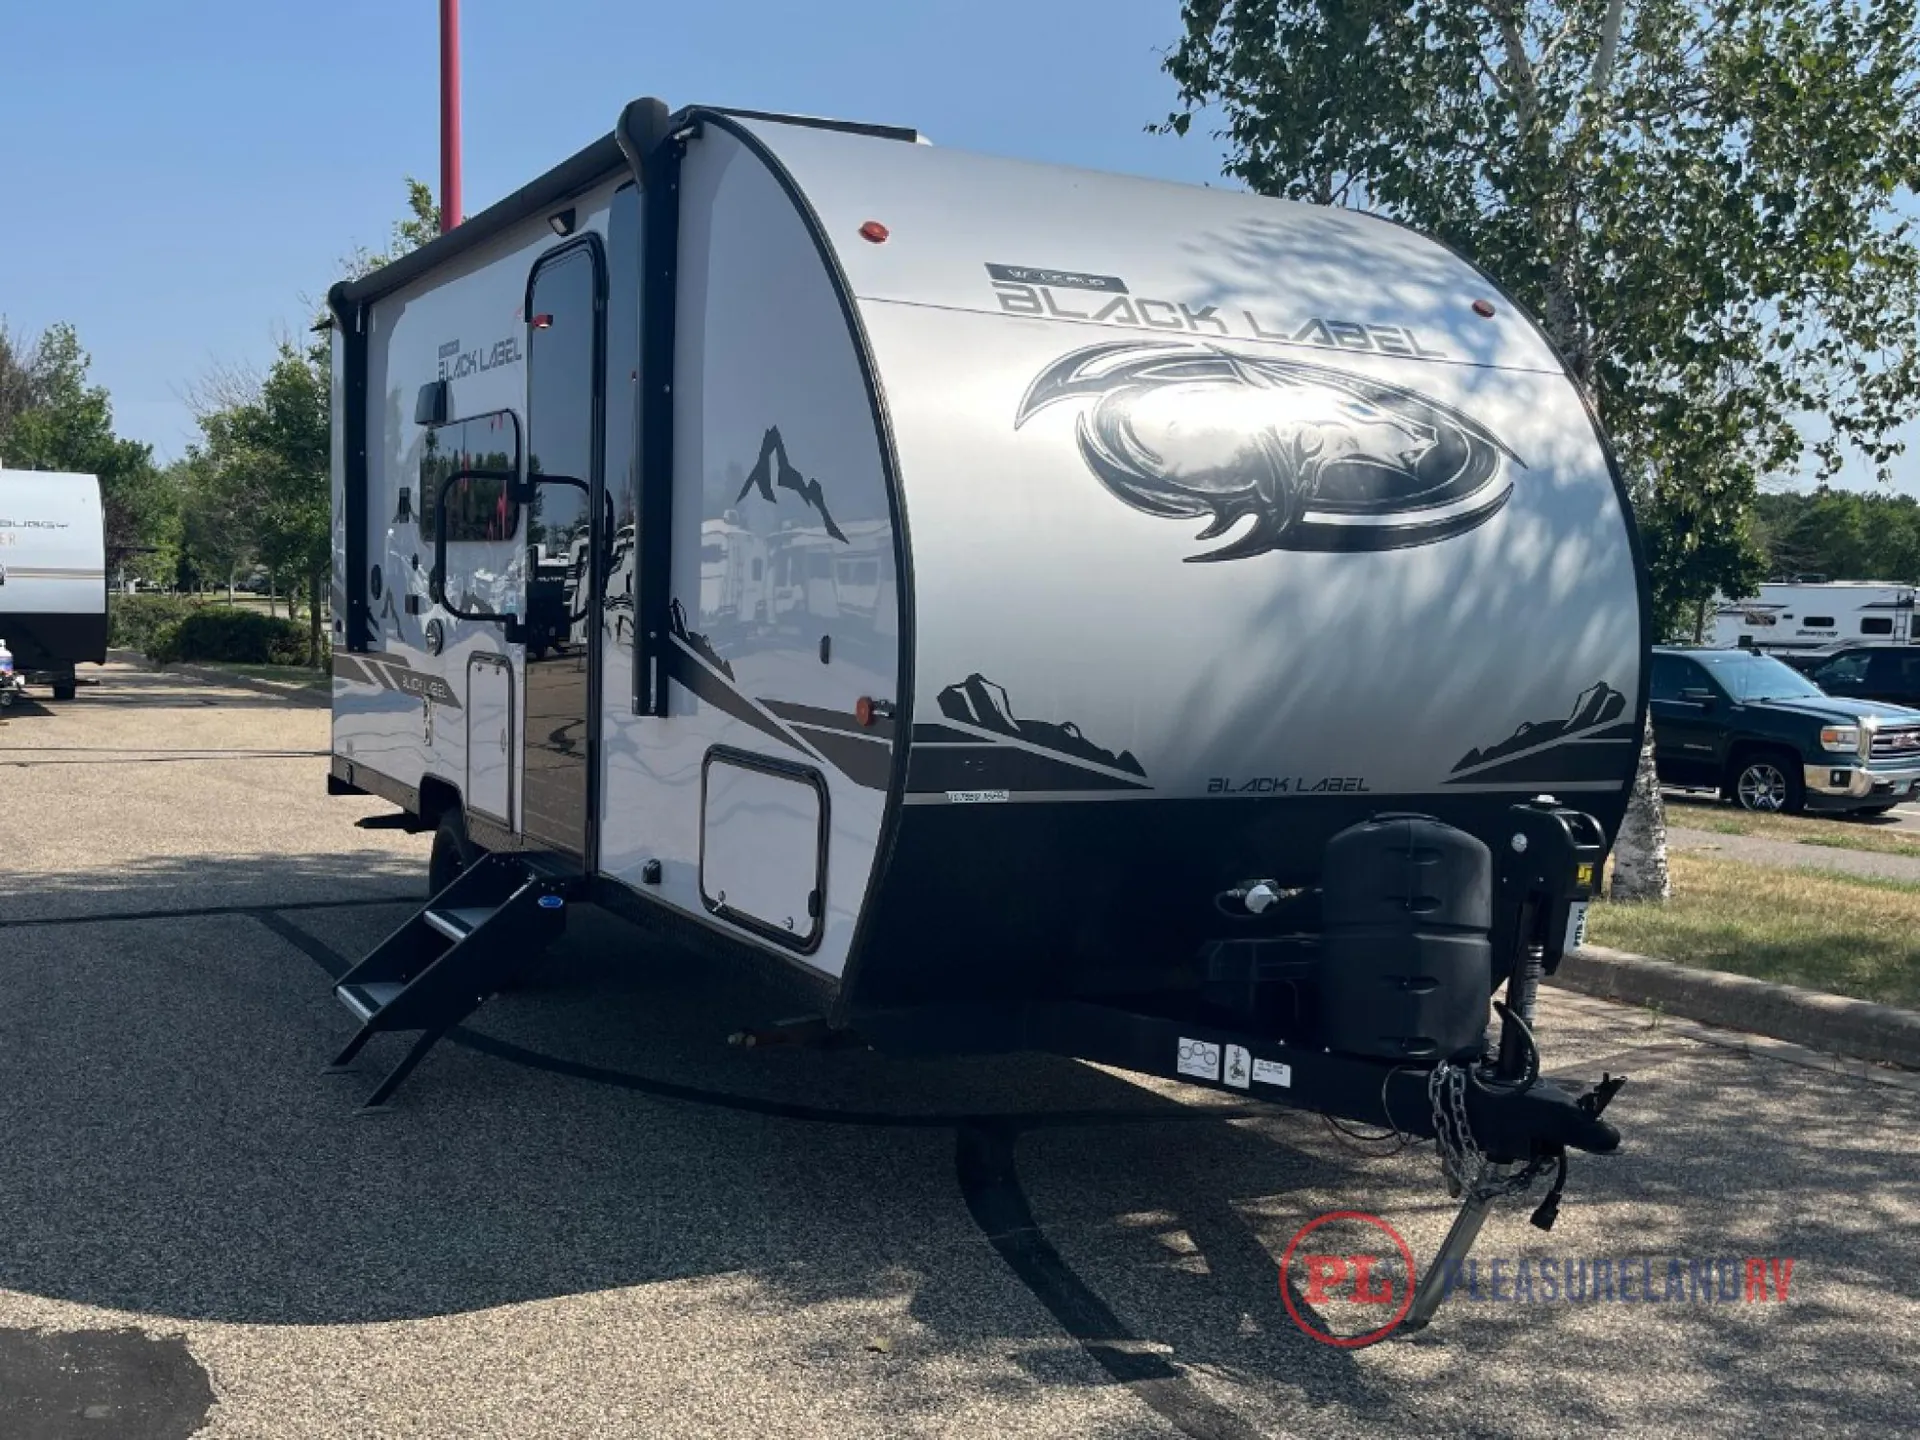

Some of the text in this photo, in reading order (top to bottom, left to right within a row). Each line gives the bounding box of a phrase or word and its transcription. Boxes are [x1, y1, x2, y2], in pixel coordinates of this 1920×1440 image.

[990, 281, 1448, 359] BLACK LABEL
[480, 337, 522, 372] LABEL
[1207, 777, 1370, 793] BLACK LABEL
